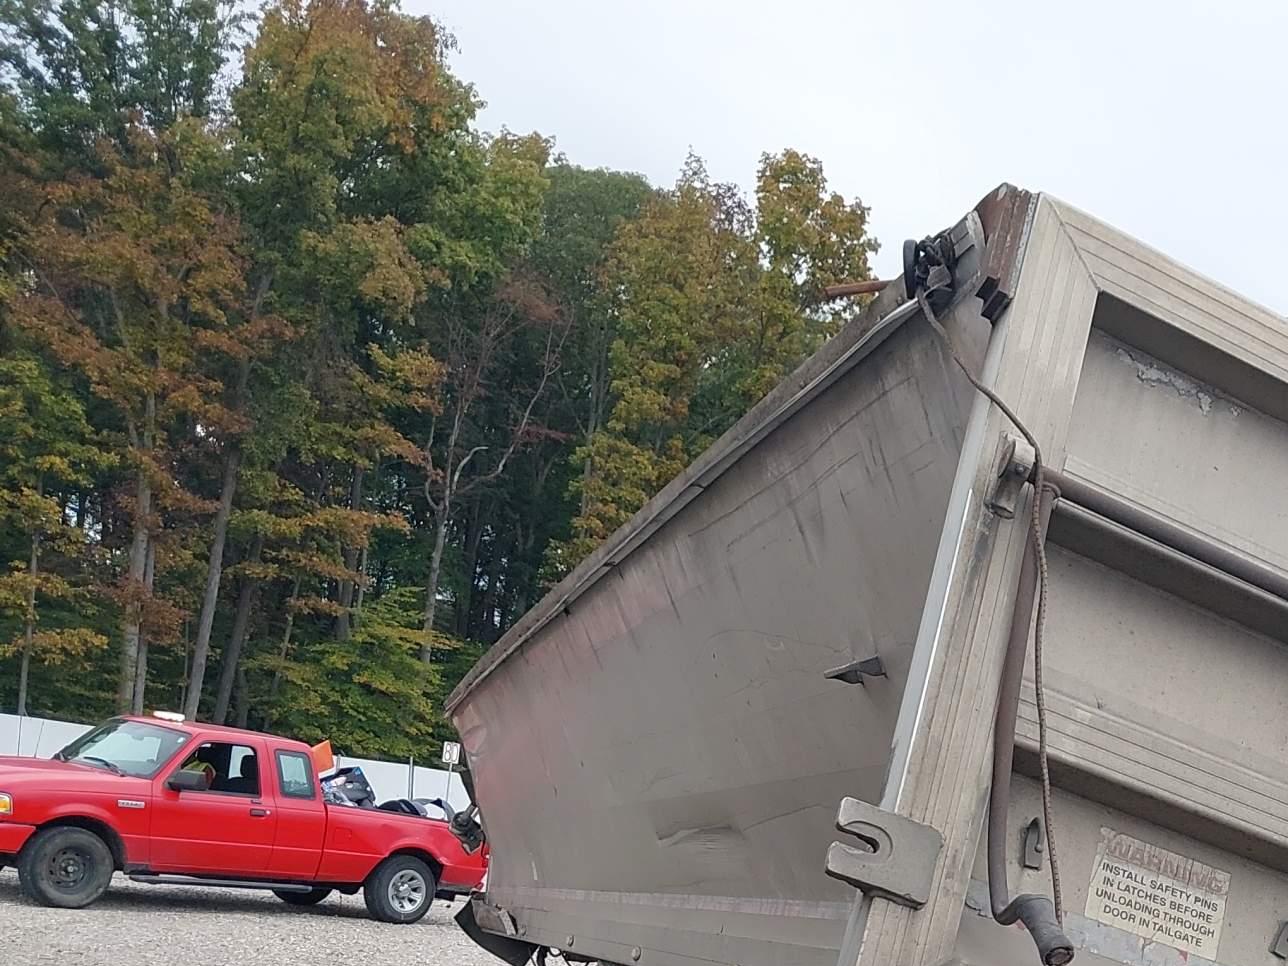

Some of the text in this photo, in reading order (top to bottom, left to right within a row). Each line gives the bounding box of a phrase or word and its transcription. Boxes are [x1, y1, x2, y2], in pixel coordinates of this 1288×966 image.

[1102, 862, 1218, 912] INSTALL SAFETY PINS
[1102, 876, 1213, 924] IN LATCHES BEFORE
[1095, 888, 1215, 938] UNLOADING THROUGH
[1103, 905, 1203, 947] DOOR IN TAILGATE
